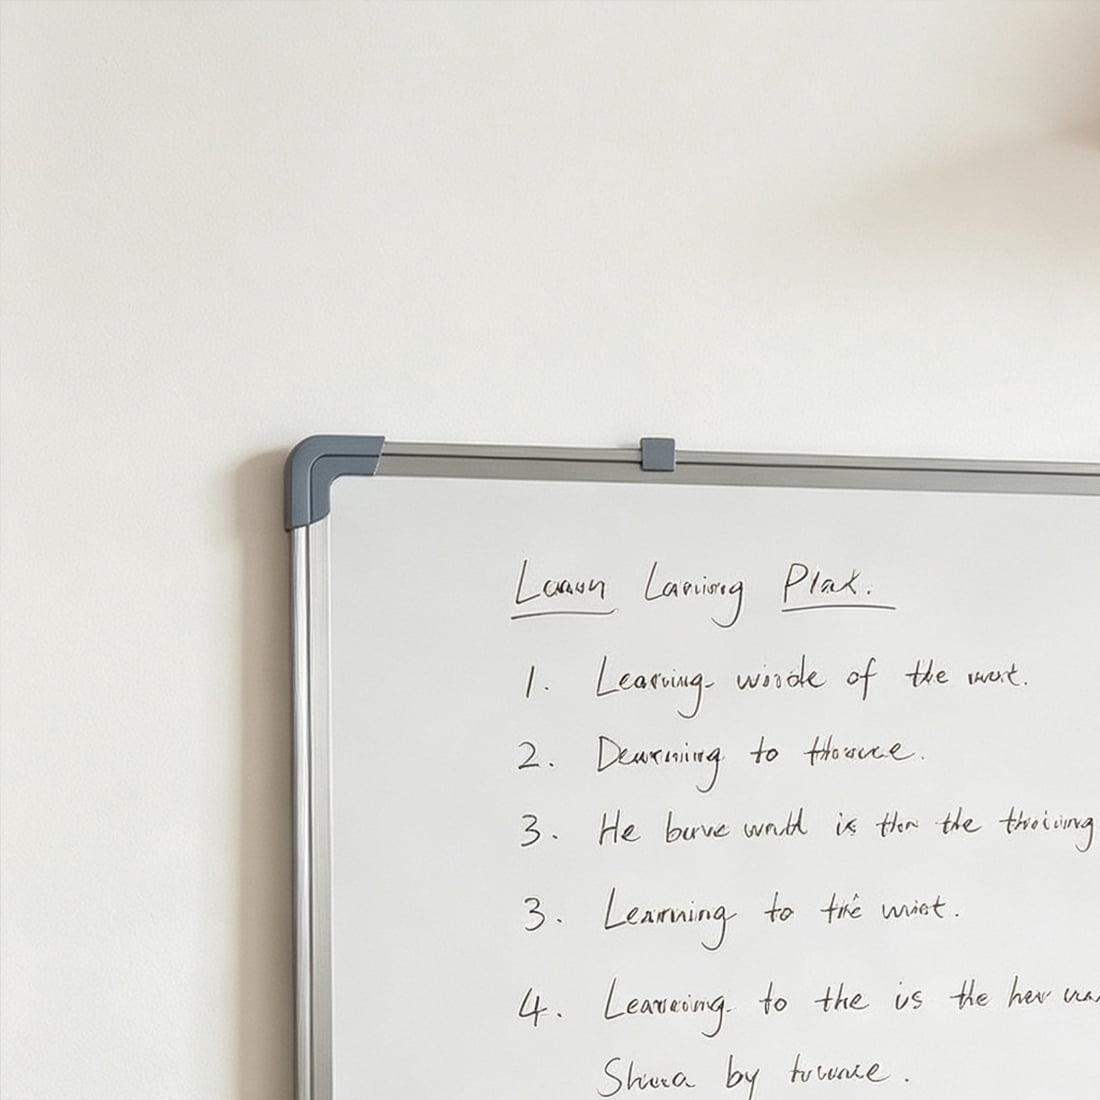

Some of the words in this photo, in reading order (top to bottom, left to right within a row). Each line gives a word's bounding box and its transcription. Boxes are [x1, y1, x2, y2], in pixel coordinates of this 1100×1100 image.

[525, 664, 550, 699] 1.
[846, 656, 878, 702] of
[904, 658, 950, 688] the
[517, 741, 555, 771] 2.
[749, 735, 780, 765] to
[520, 813, 559, 848] 3.
[598, 808, 642, 846] He
[934, 806, 983, 835] the
[523, 897, 563, 932] 3.
[763, 891, 795, 924] to
[518, 987, 563, 1028] 4.
[758, 980, 788, 1016] to
[813, 981, 870, 1013] the
[949, 978, 990, 1011] the
